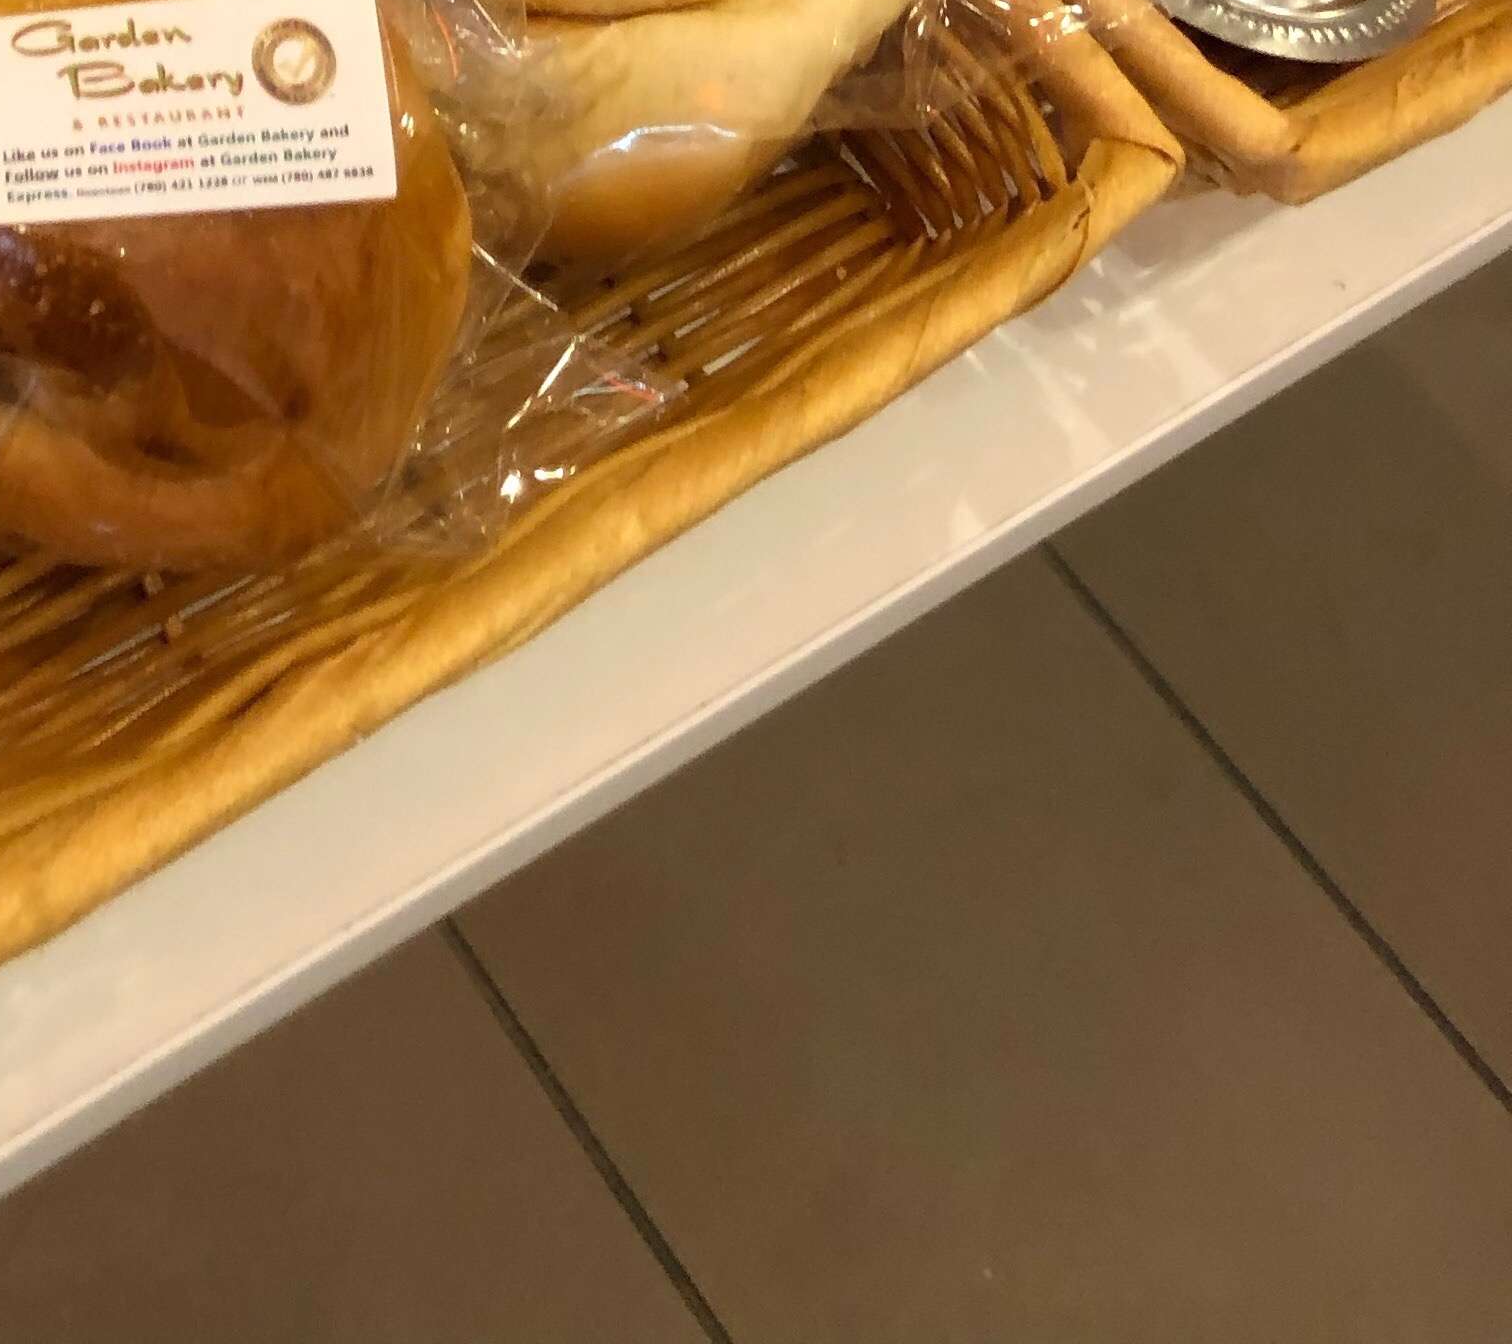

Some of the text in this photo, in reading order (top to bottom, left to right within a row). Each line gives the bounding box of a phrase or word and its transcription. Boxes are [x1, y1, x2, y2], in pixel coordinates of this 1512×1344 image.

[11, 18, 192, 57] Garden
[57, 60, 244, 100] Bakery
[2, 123, 350, 164] Like us on Face Book at Garden Bakery and
[4, 147, 337, 184] Follow us on Instagram at Garden Bakery
